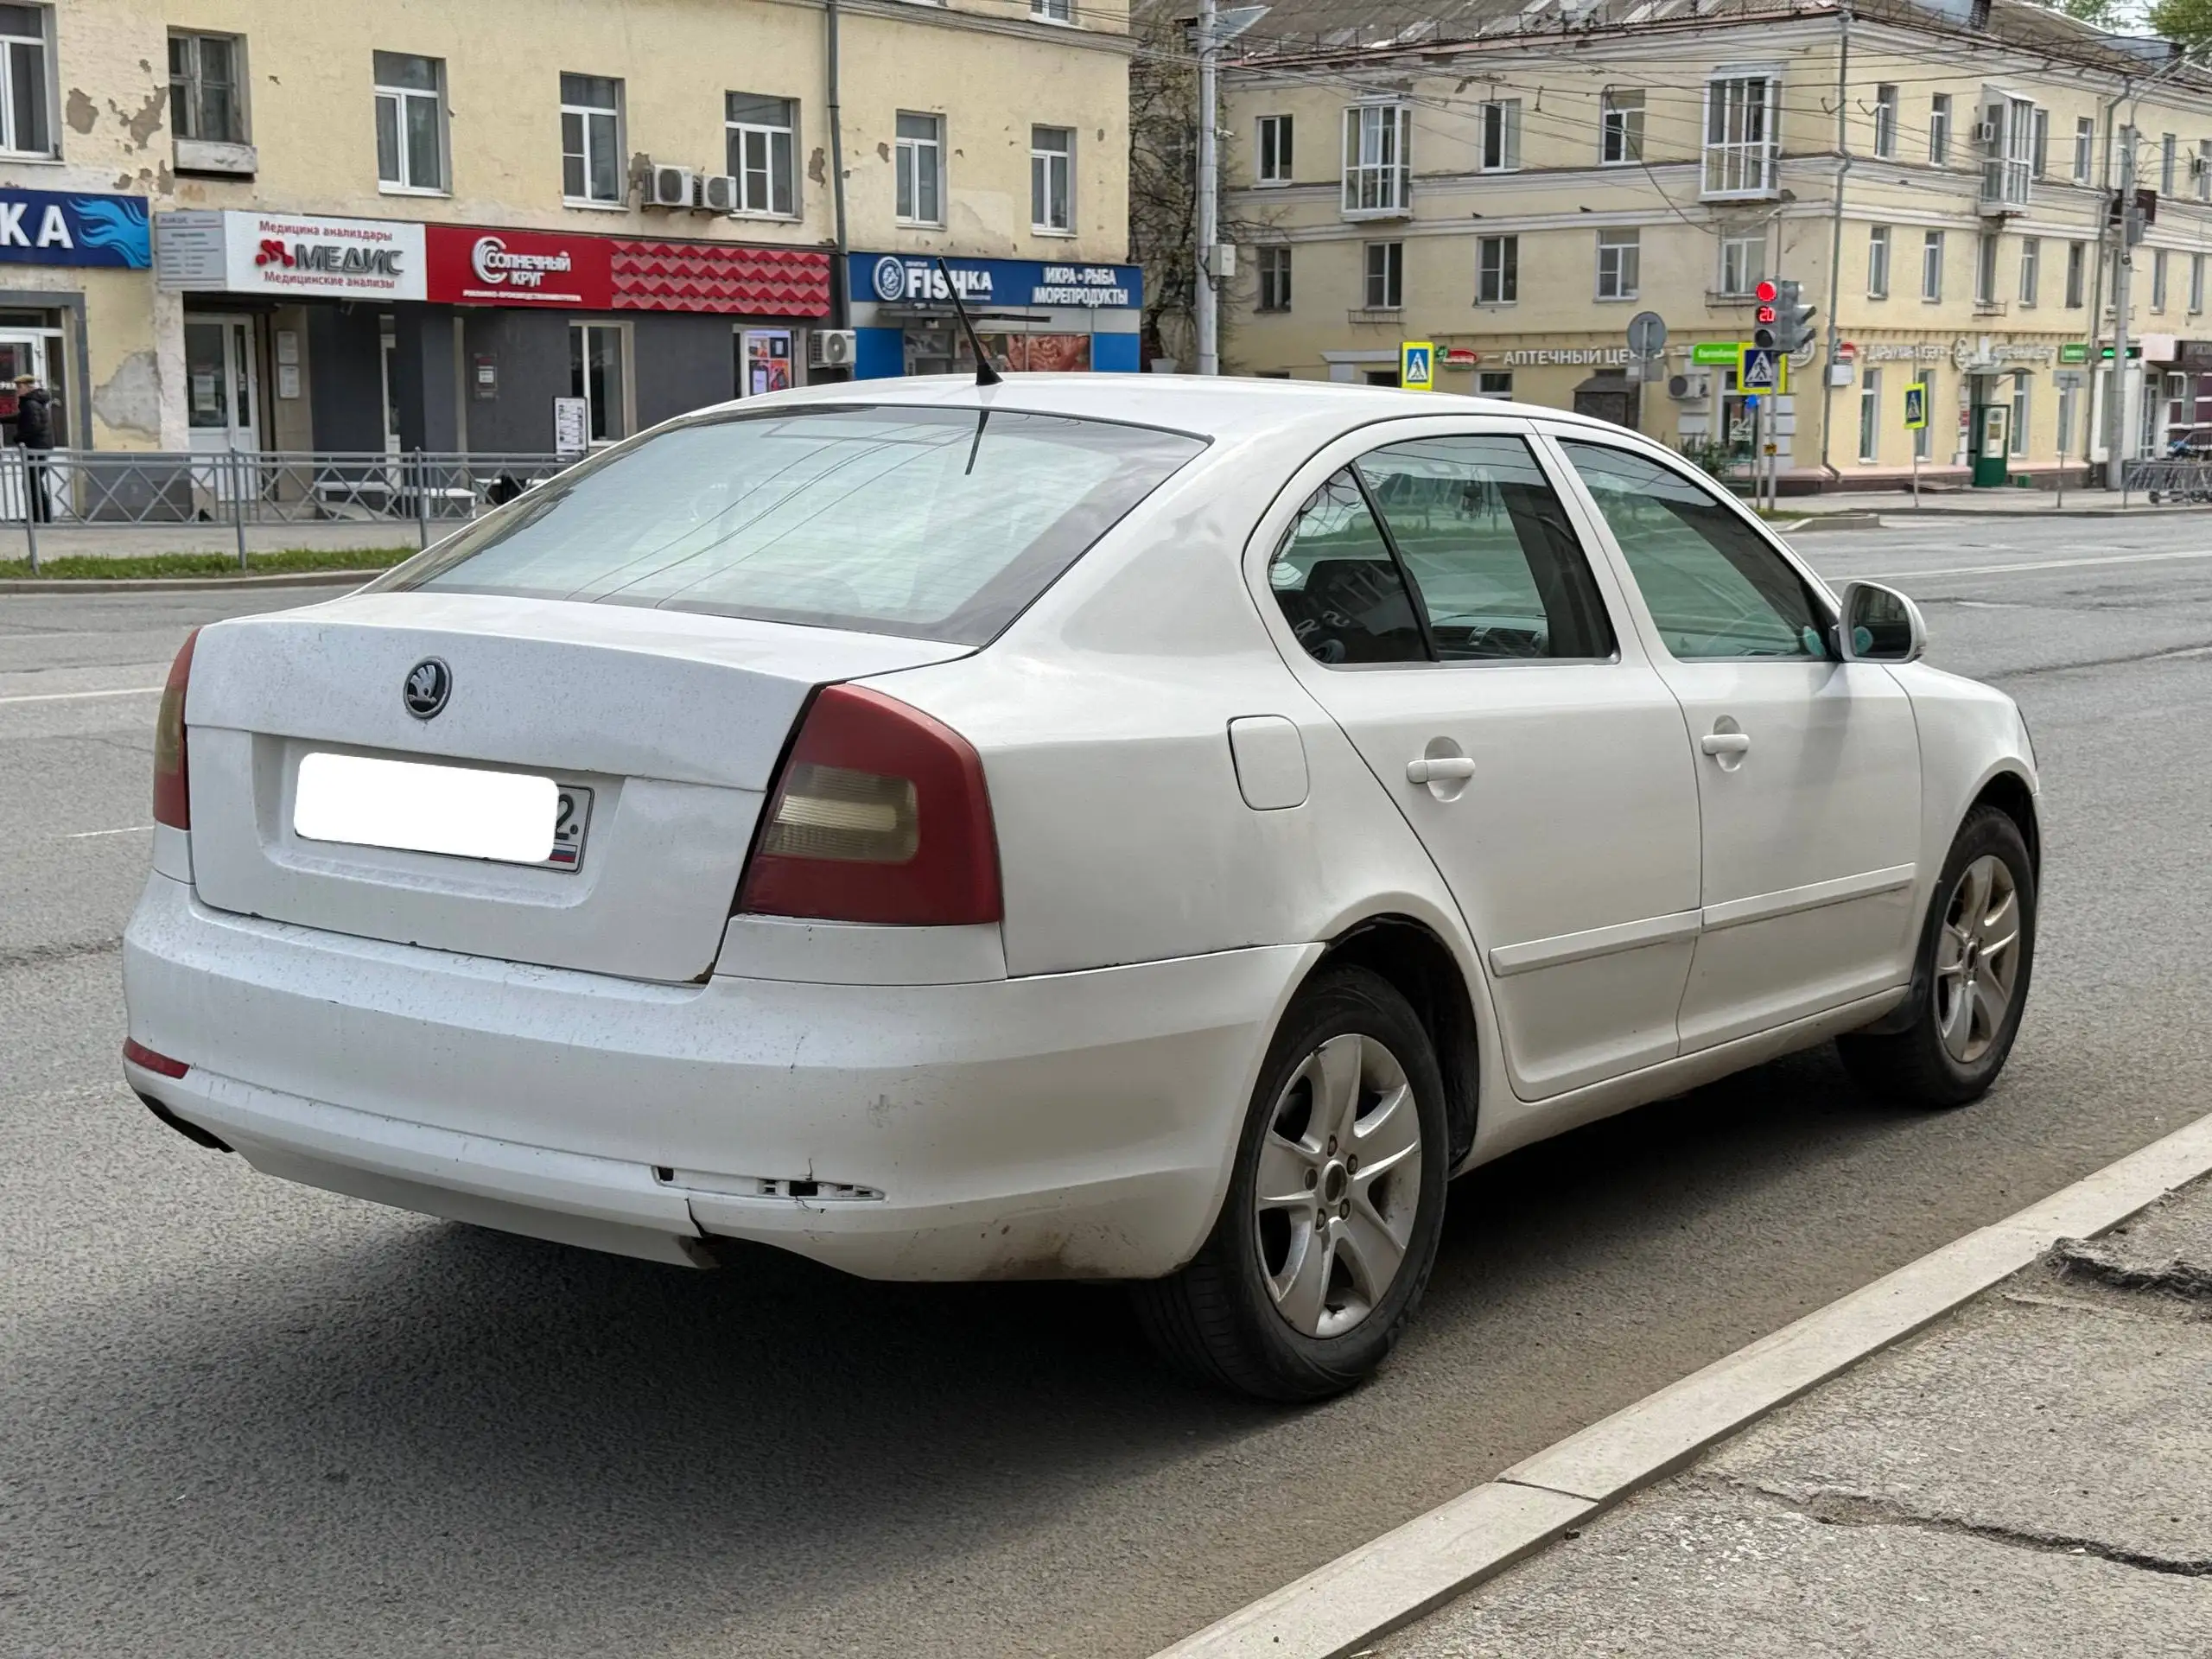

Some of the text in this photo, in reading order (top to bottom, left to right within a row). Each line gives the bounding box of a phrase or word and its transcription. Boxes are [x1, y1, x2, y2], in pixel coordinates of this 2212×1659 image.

[258, 220, 320, 236] Медицина
[295, 244, 404, 276] МЕДИС
[264, 270, 395, 289] Медицинские анализы
[510, 270, 545, 287] КРУГ
[1043, 267, 1117, 285] ИКРА РЫБА
[1033, 286, 1128, 308] МОРЕПРОДУКТЫ
[1758, 308, 1776, 322] 20
[1503, 346, 1601, 366] АПТЕЧНЫЙ
